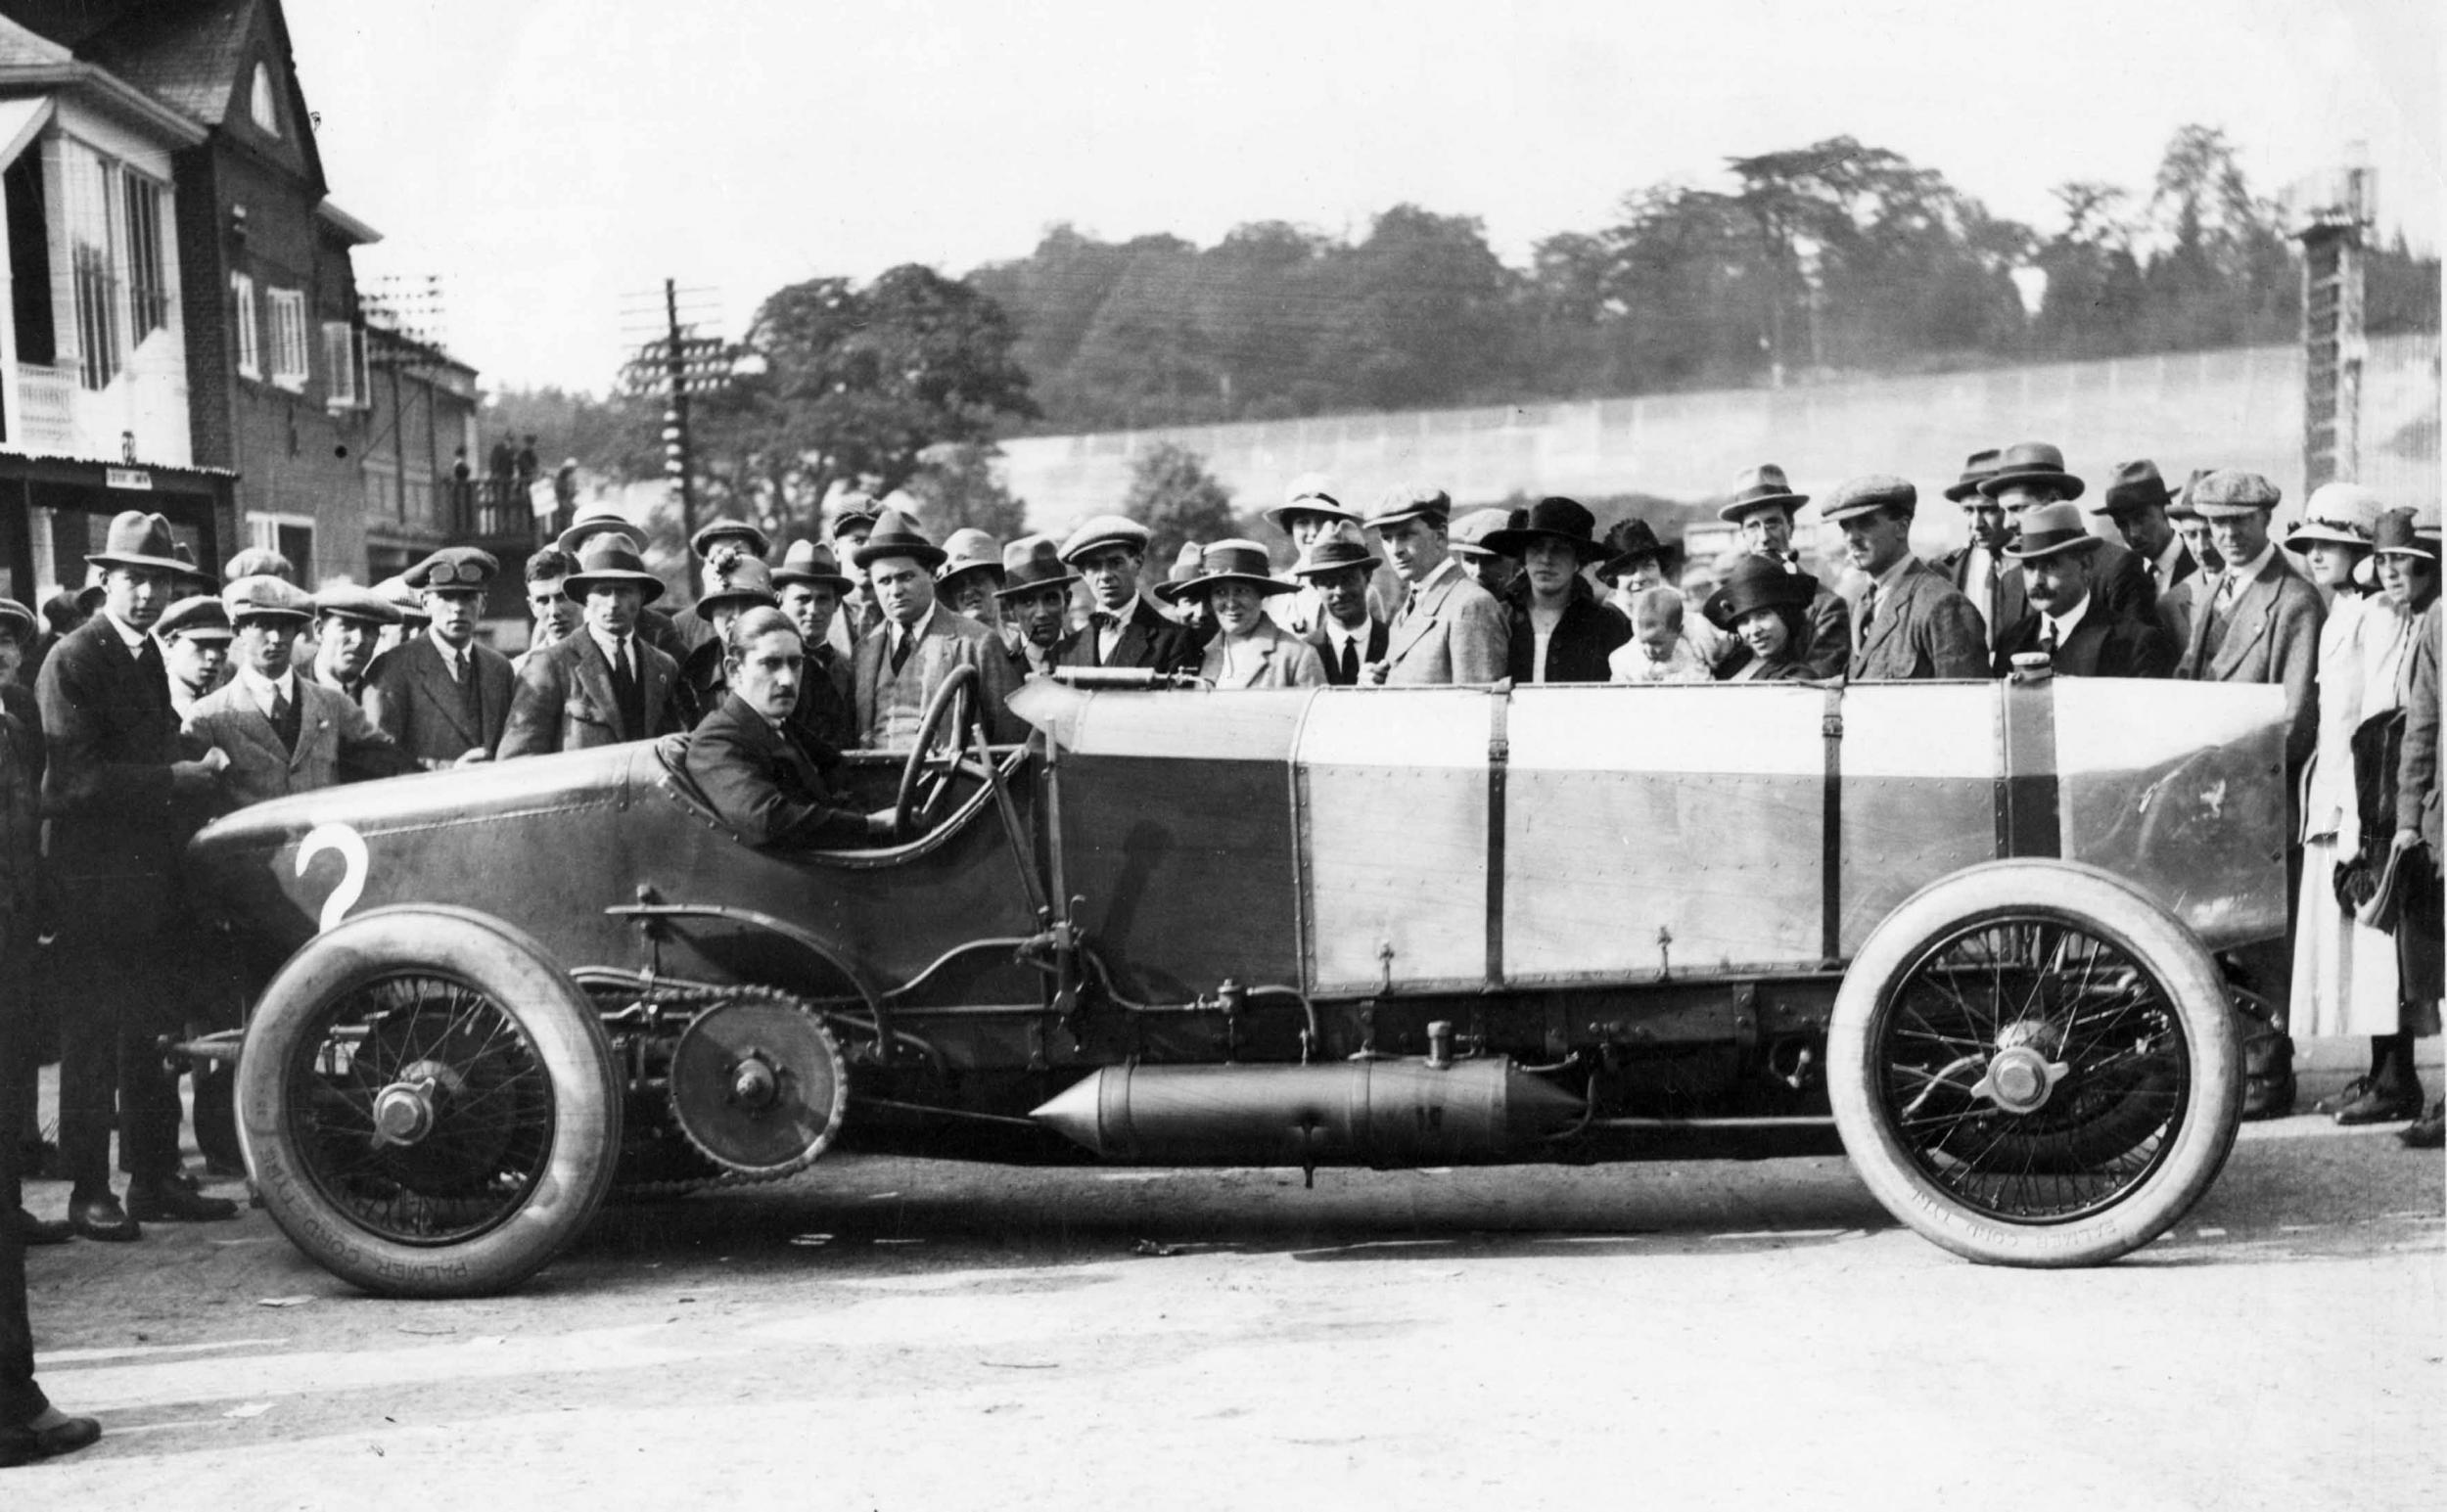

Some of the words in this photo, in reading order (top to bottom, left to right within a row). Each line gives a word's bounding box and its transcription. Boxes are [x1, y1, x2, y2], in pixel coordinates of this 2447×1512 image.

[296, 822, 368, 936] 2
[304, 1219, 360, 1264] CORD
[2036, 1219, 2117, 1250] PALMER
[376, 1262, 467, 1280] PALMER
